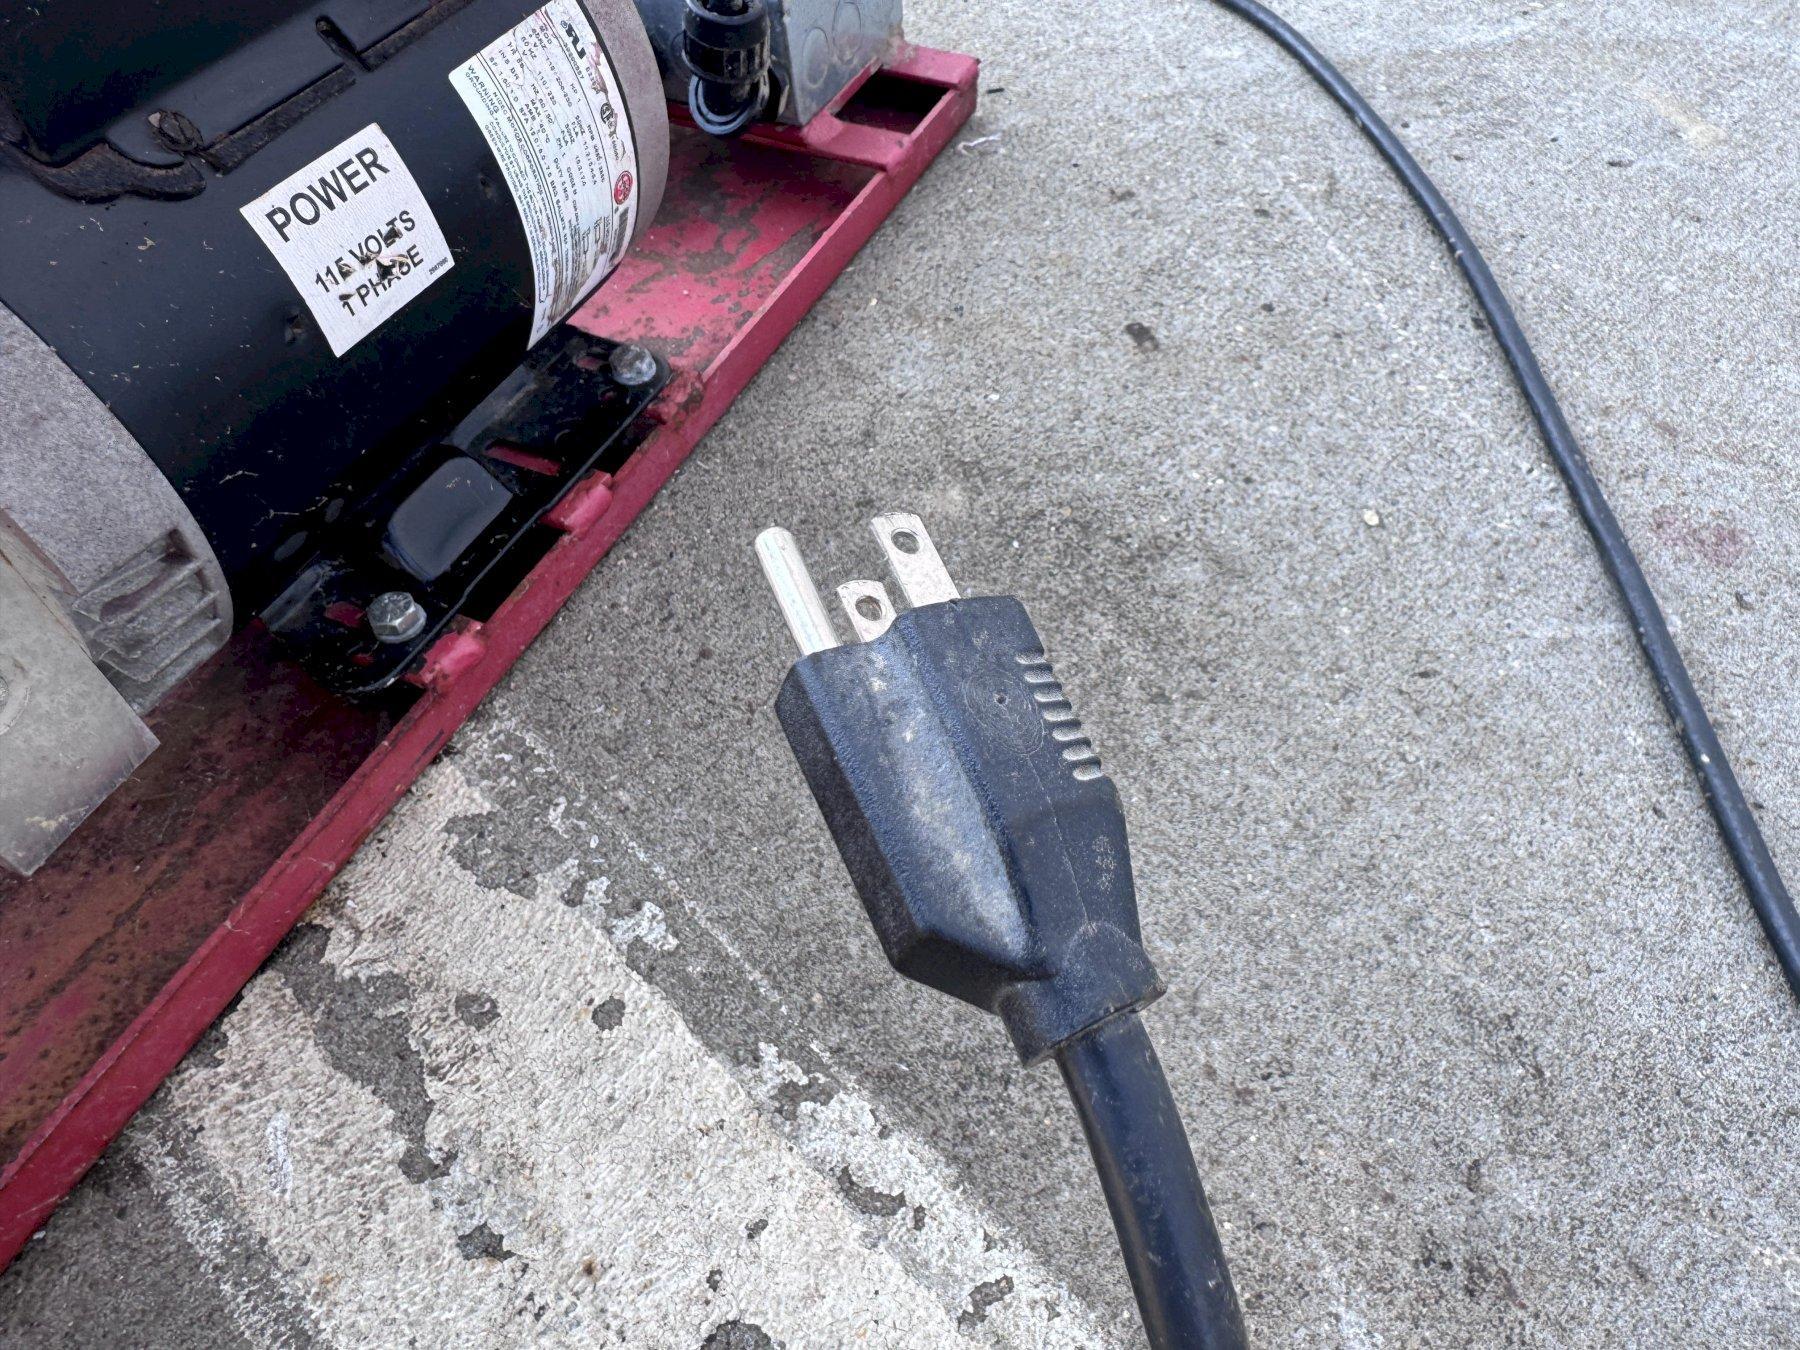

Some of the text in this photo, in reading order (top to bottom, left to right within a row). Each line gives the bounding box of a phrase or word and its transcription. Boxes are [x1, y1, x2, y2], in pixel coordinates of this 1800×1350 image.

[466, 63, 501, 114] WARNING
[265, 147, 390, 243] POWER
[349, 210, 416, 266] VOLTS
[341, 299, 356, 317] 1
